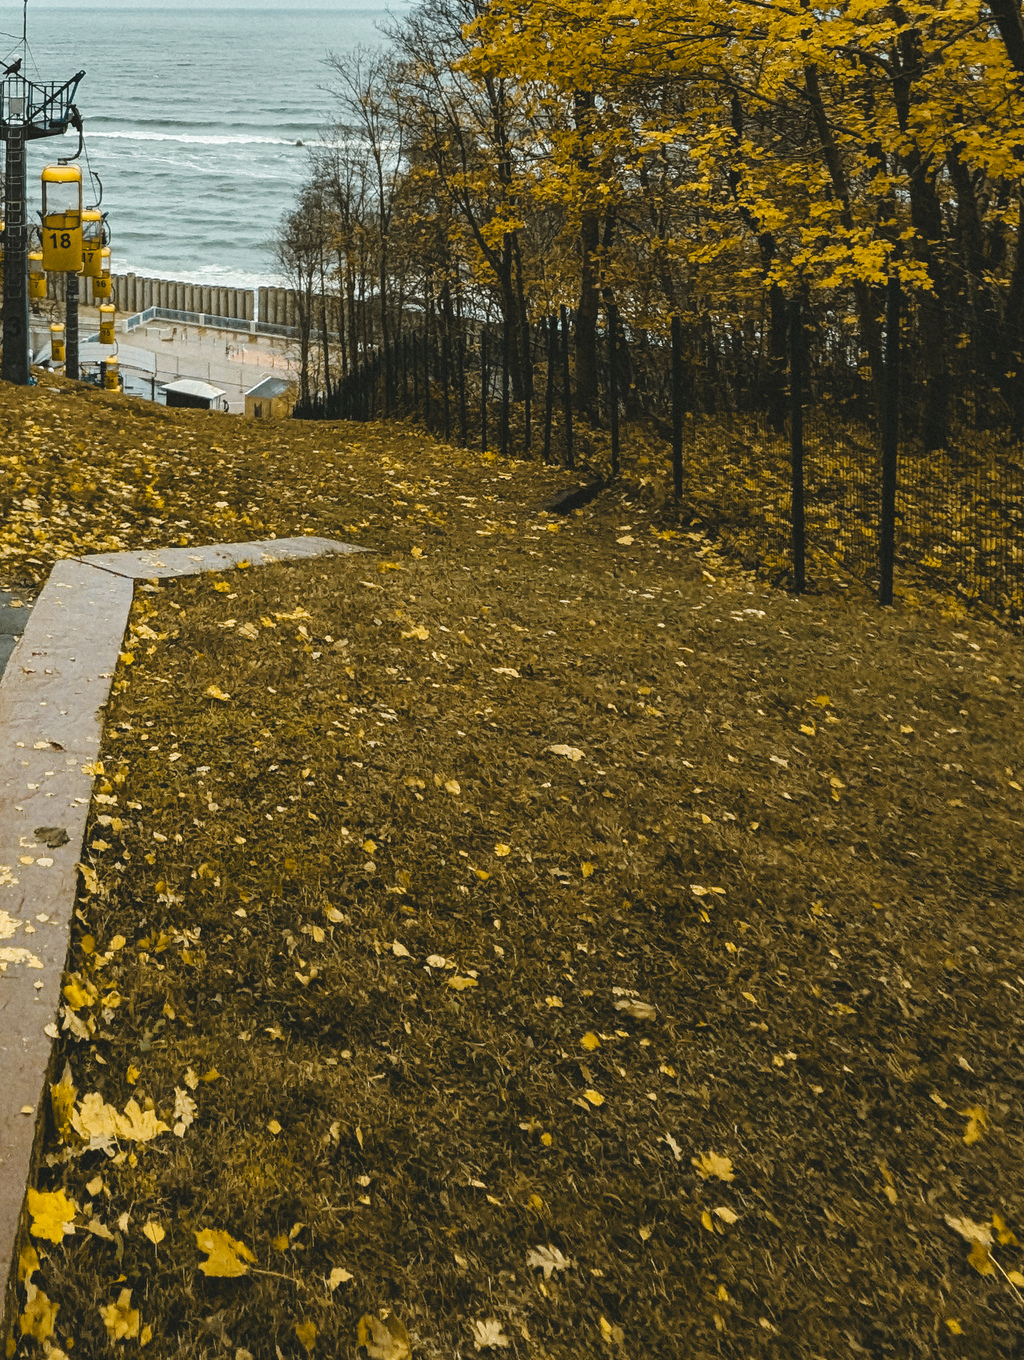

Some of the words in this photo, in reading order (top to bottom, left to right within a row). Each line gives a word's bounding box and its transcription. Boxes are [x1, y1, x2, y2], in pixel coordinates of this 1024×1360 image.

[50, 233, 71, 249] 18
[82, 253, 94, 263] 17
[96, 279, 107, 288] 16
